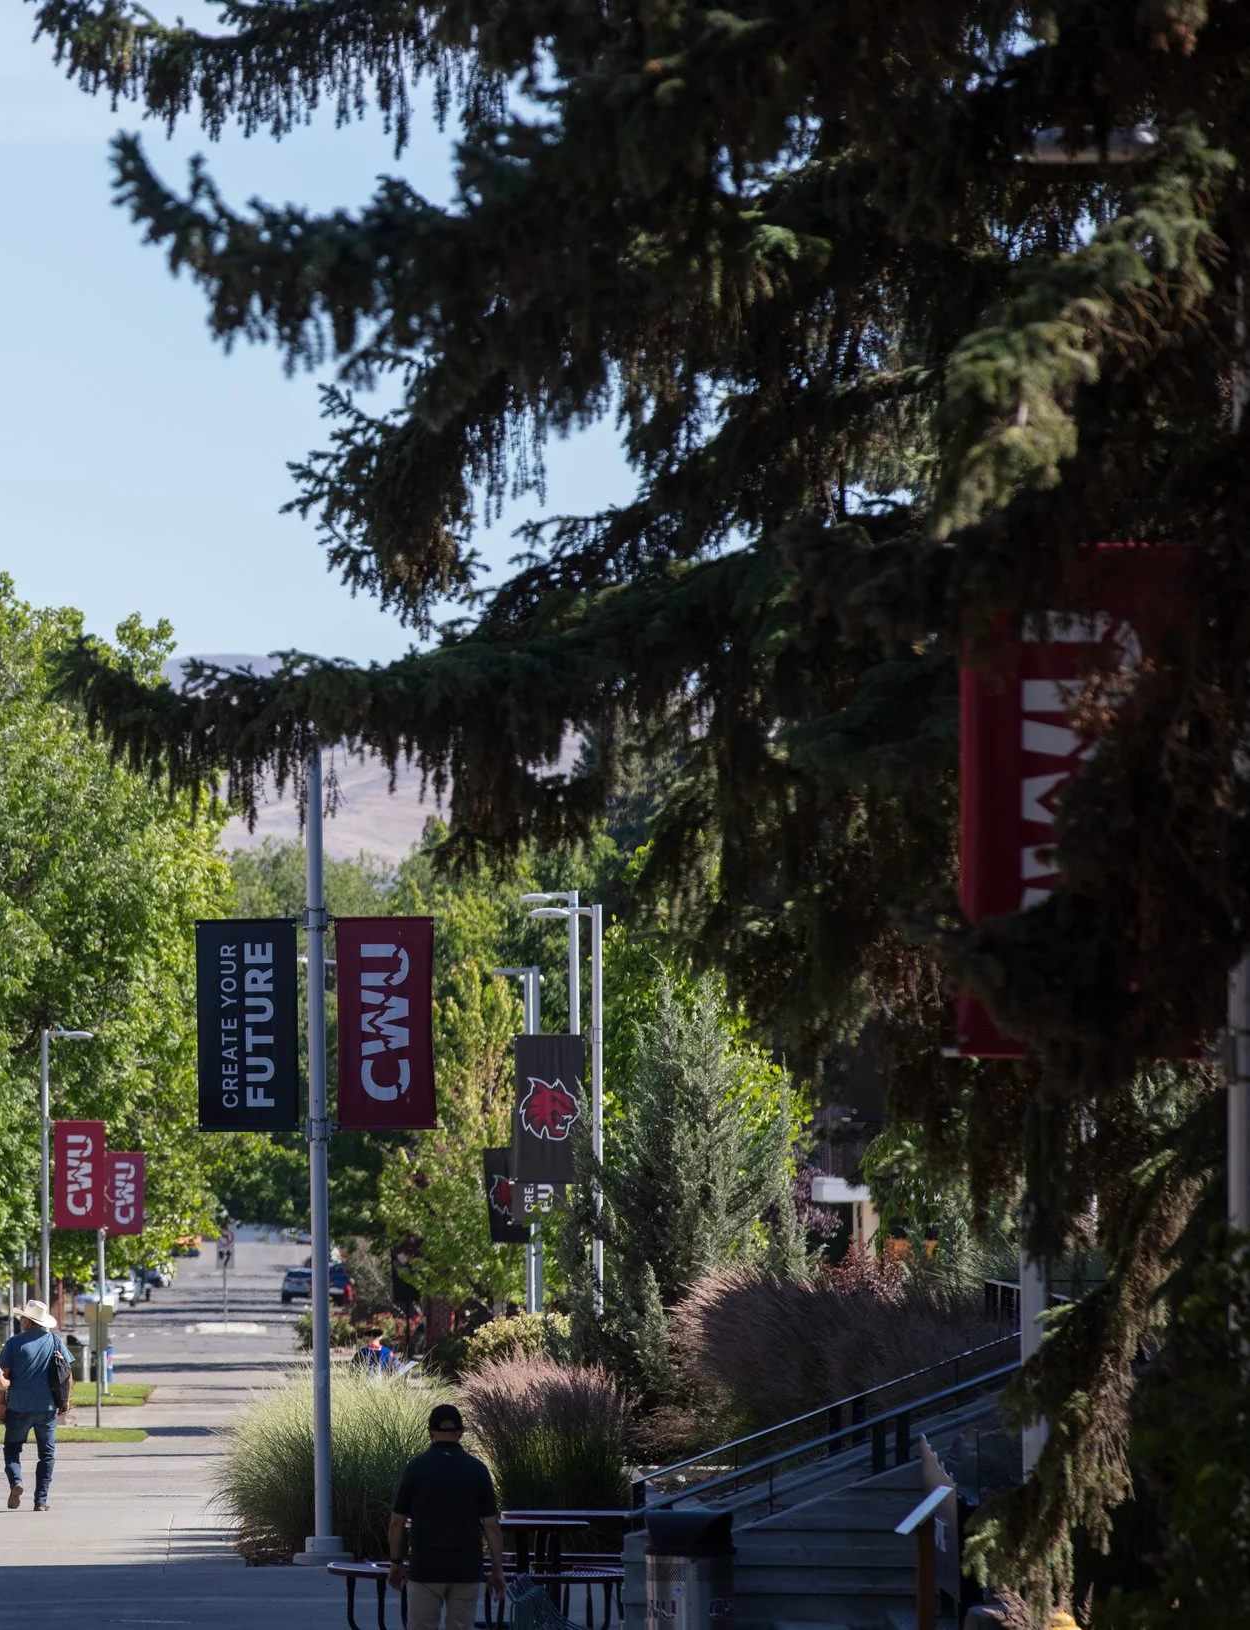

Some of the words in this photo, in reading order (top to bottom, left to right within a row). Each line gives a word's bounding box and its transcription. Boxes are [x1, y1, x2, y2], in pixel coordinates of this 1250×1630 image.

[219, 944, 238, 1009] YOUR
[221, 1018, 239, 1109] CREATE
[243, 942, 275, 1108] FUTURE
[360, 943, 411, 1102] CWU
[66, 1134, 93, 1216] CWU
[114, 1162, 136, 1225] CWU
[524, 1183, 534, 1213] CRE
